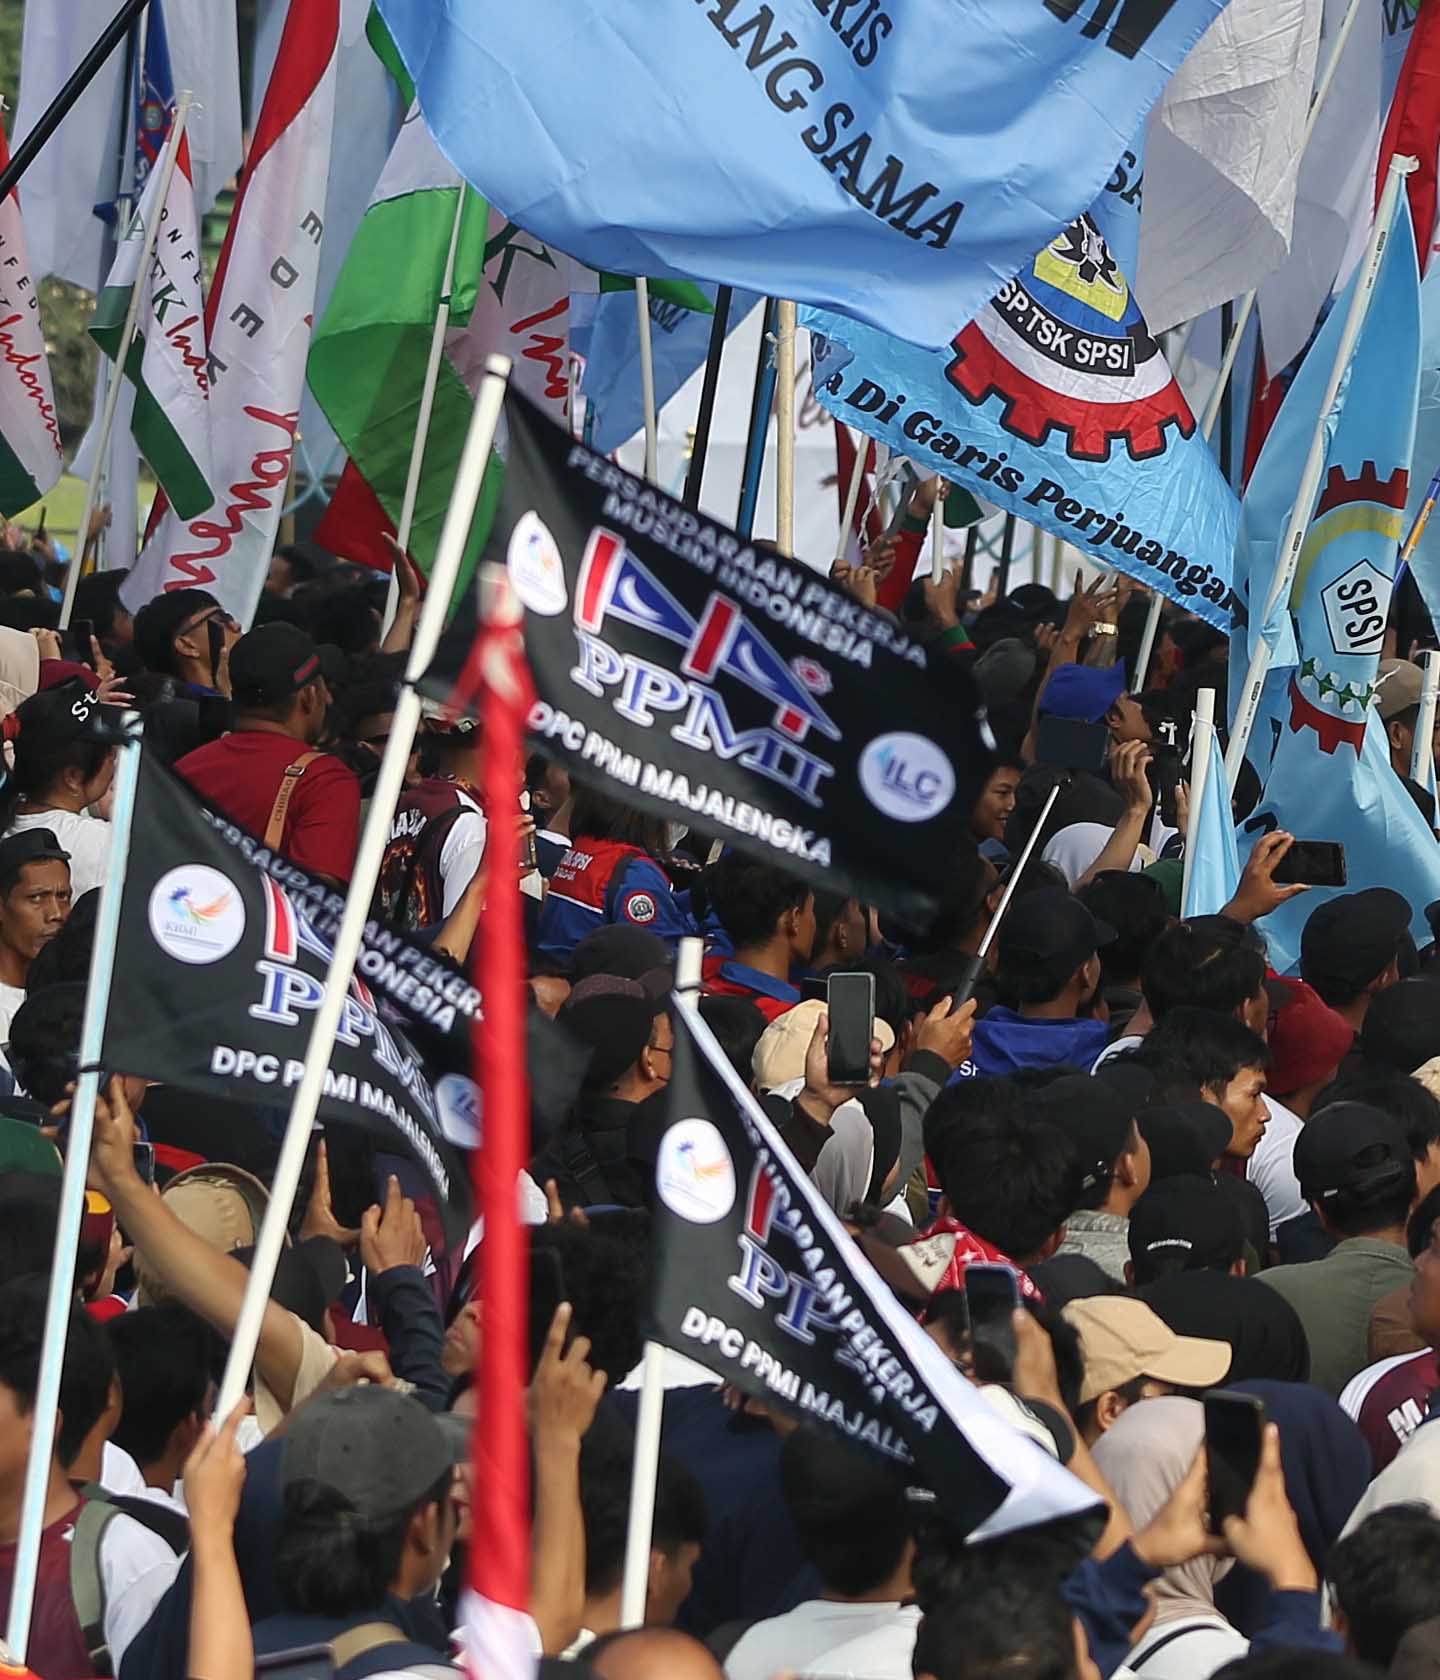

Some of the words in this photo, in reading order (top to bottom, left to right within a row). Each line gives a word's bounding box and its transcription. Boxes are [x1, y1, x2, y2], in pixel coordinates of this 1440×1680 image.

[802, 103, 965, 251] SAMA
[1074, 338, 1130, 371] SPSI
[844, 377, 906, 425] Di
[904, 410, 1026, 494] Garis
[566, 444, 802, 596] PERSAUDARAAN
[804, 586, 927, 670] PEKERJA
[602, 497, 714, 575] MUSLIM
[716, 566, 873, 668] INDONESIA
[1336, 577, 1385, 650] SPSI
[571, 630, 834, 807] PPMI
[527, 702, 584, 752] DPC
[582, 740, 641, 788] PPMI
[640, 761, 833, 868] MAJALENGKA
[885, 757, 943, 803] ILC
[399, 941, 484, 1021] PEKER
[211, 1046, 279, 1084] DPC
[283, 1062, 357, 1102] PMI
[681, 1307, 744, 1358] DPC
[742, 1340, 799, 1401] PPMI
[839, 1309, 938, 1432] PEKERJA
